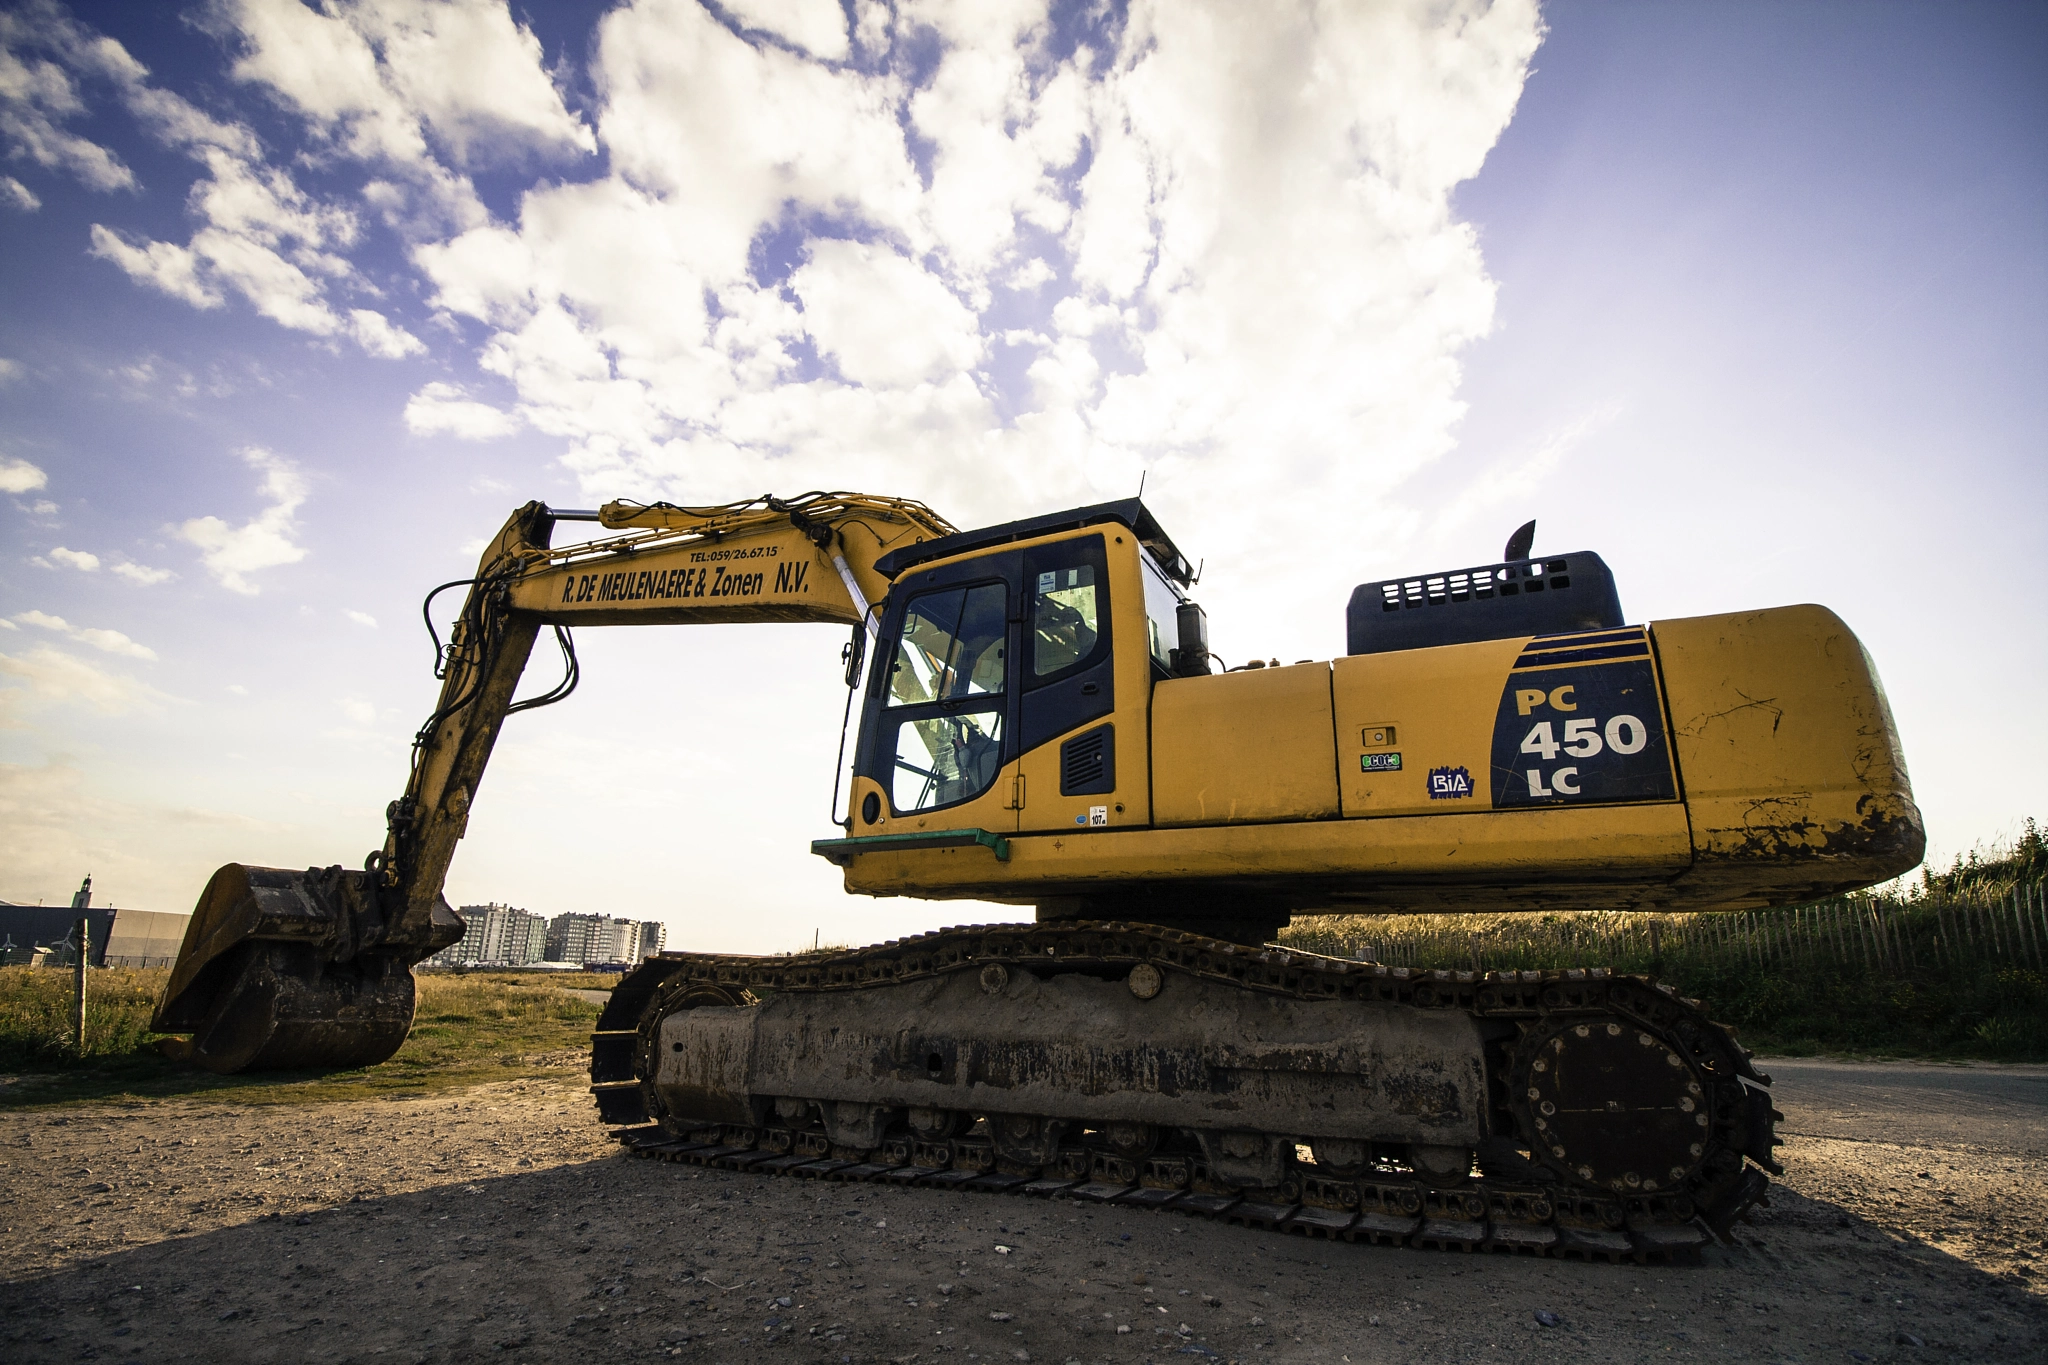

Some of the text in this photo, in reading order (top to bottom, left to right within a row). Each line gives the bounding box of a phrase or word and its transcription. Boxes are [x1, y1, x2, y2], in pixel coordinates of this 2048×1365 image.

[690, 546, 778, 563] TEL:059/26.67.15
[562, 561, 810, 603] R. DE MEULENAERE & Zonen N.V.
[1515, 685, 1577, 716] PC
[1520, 714, 1647, 760] 450
[1526, 766, 1581, 797] LC
[1092, 814, 1102, 825] 107
